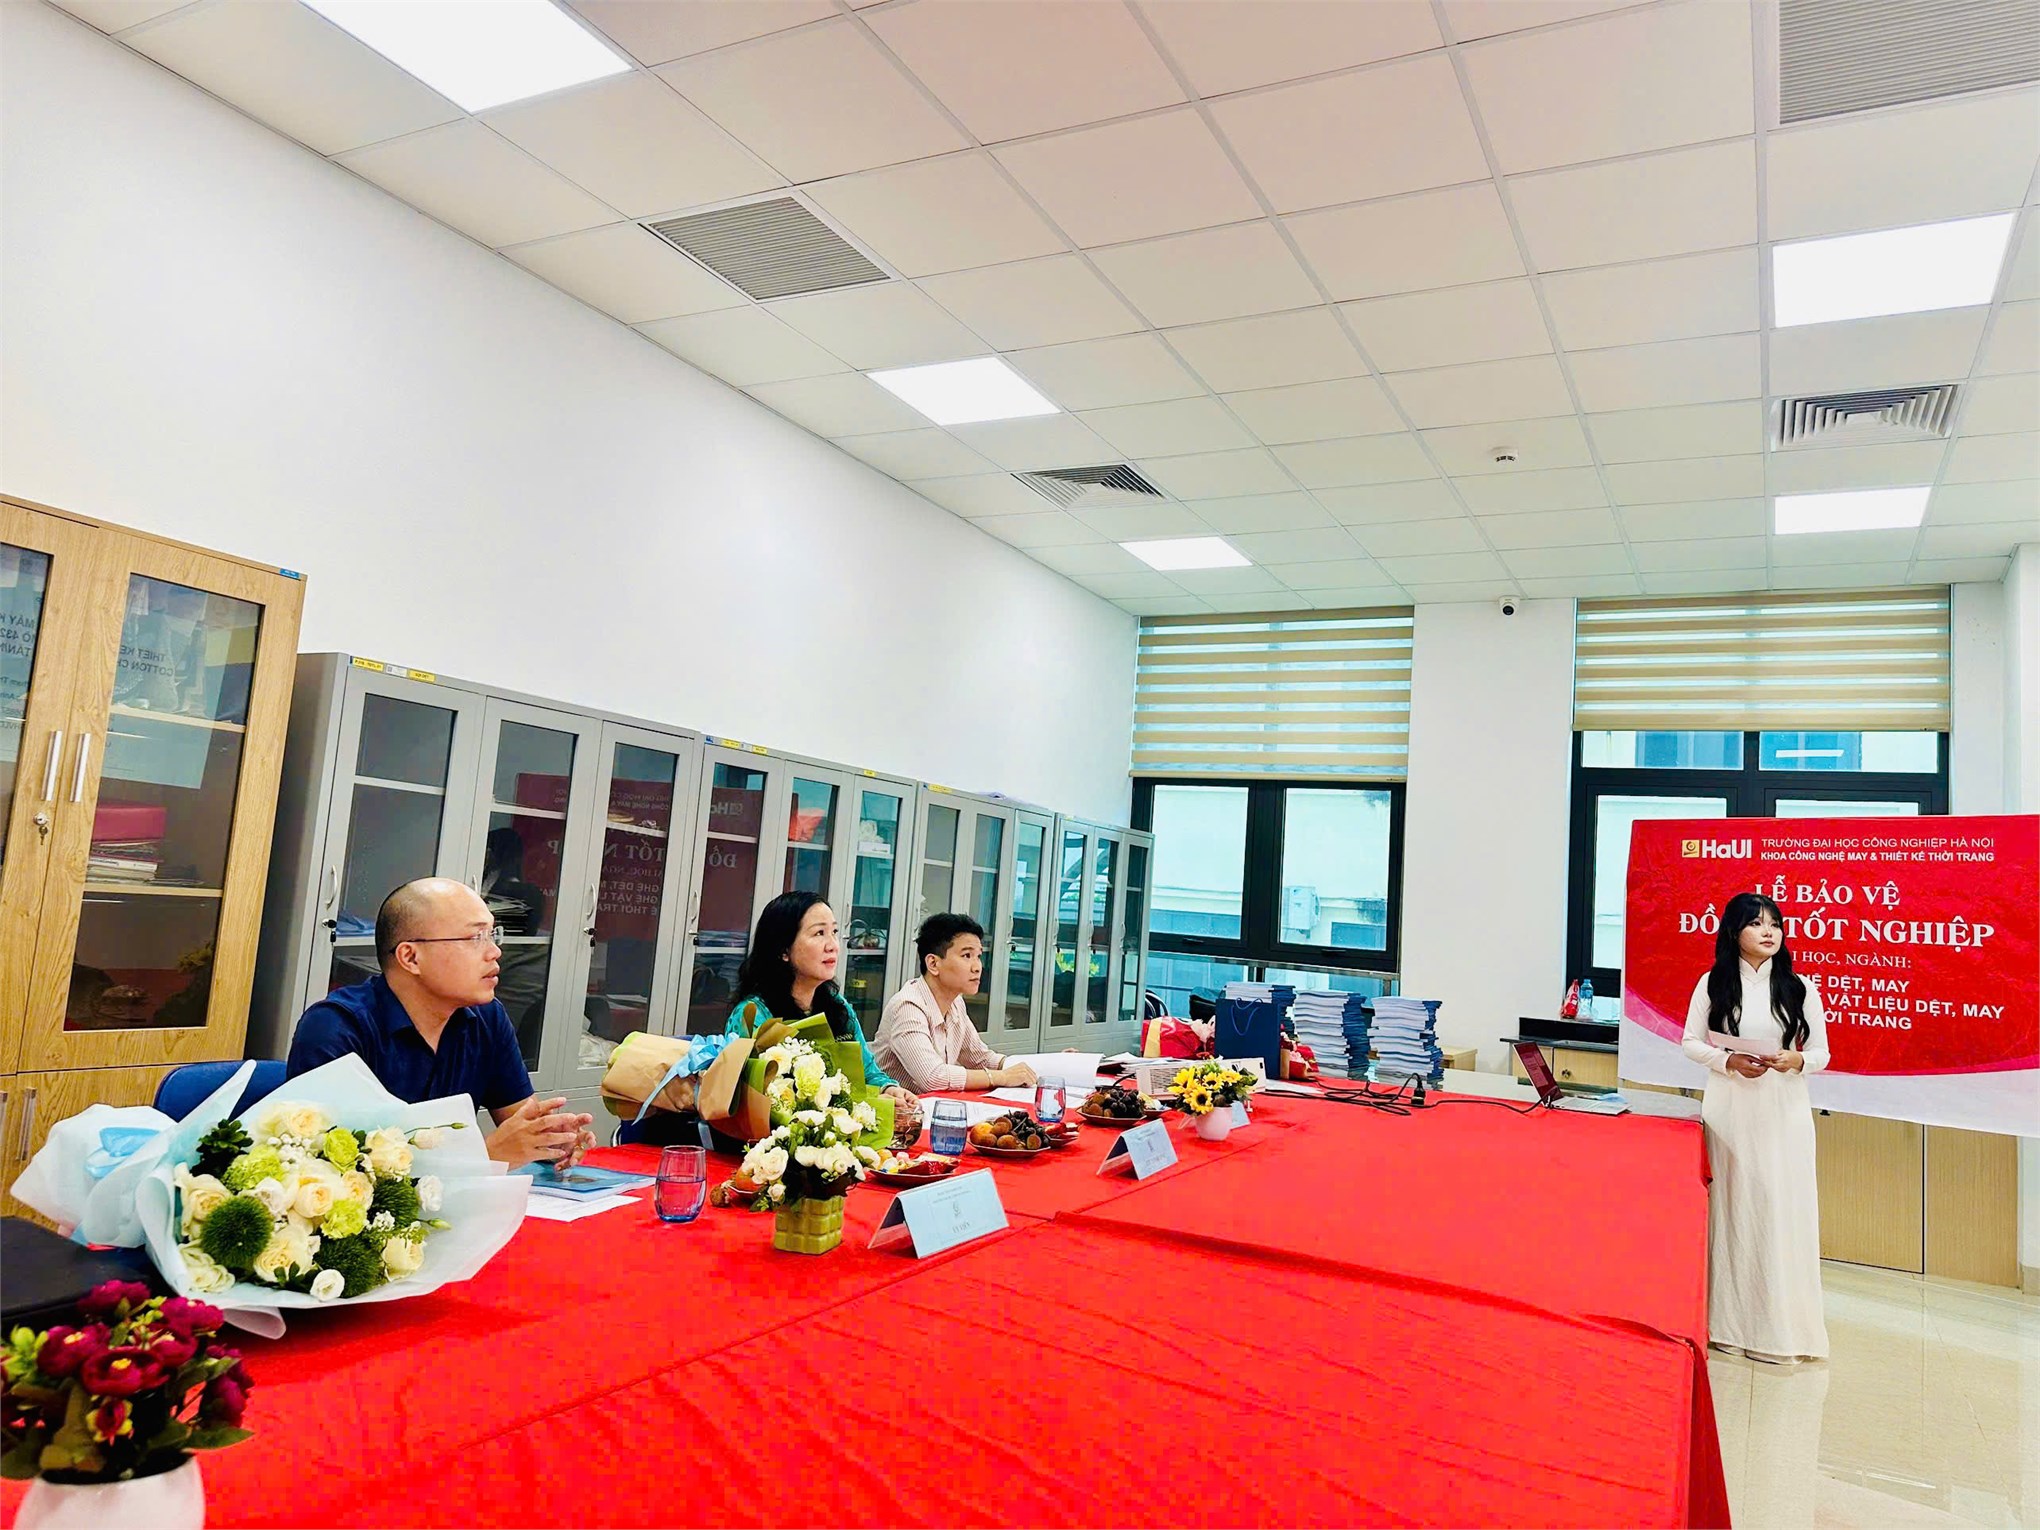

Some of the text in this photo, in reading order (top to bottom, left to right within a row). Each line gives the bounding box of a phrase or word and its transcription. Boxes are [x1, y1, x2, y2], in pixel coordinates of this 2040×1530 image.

[1761, 836, 1995, 850] TRƯỜNG ĐẠI HỌC CÔNG NGHIỆP HÀ NỘI
[1760, 850, 1995, 863] KHOA CÔNG NGHỆ MAY & THIẾT KẾ THỜI TRANG
[1795, 878, 1854, 905] BẢO
[1861, 880, 1901, 911] VỆ
[1679, 903, 1995, 953] ĐỒ TỐT NGHIỆP
[1802, 951, 1841, 966] HỌC,
[1845, 952, 1911, 969] NGÀNH:
[1827, 974, 1865, 992] DỆT,
[1871, 978, 1910, 993] MAY
[1827, 993, 2005, 1019] VẬT LIỆU DỆT, MAY
[1848, 1012, 1912, 1030] TRANG
